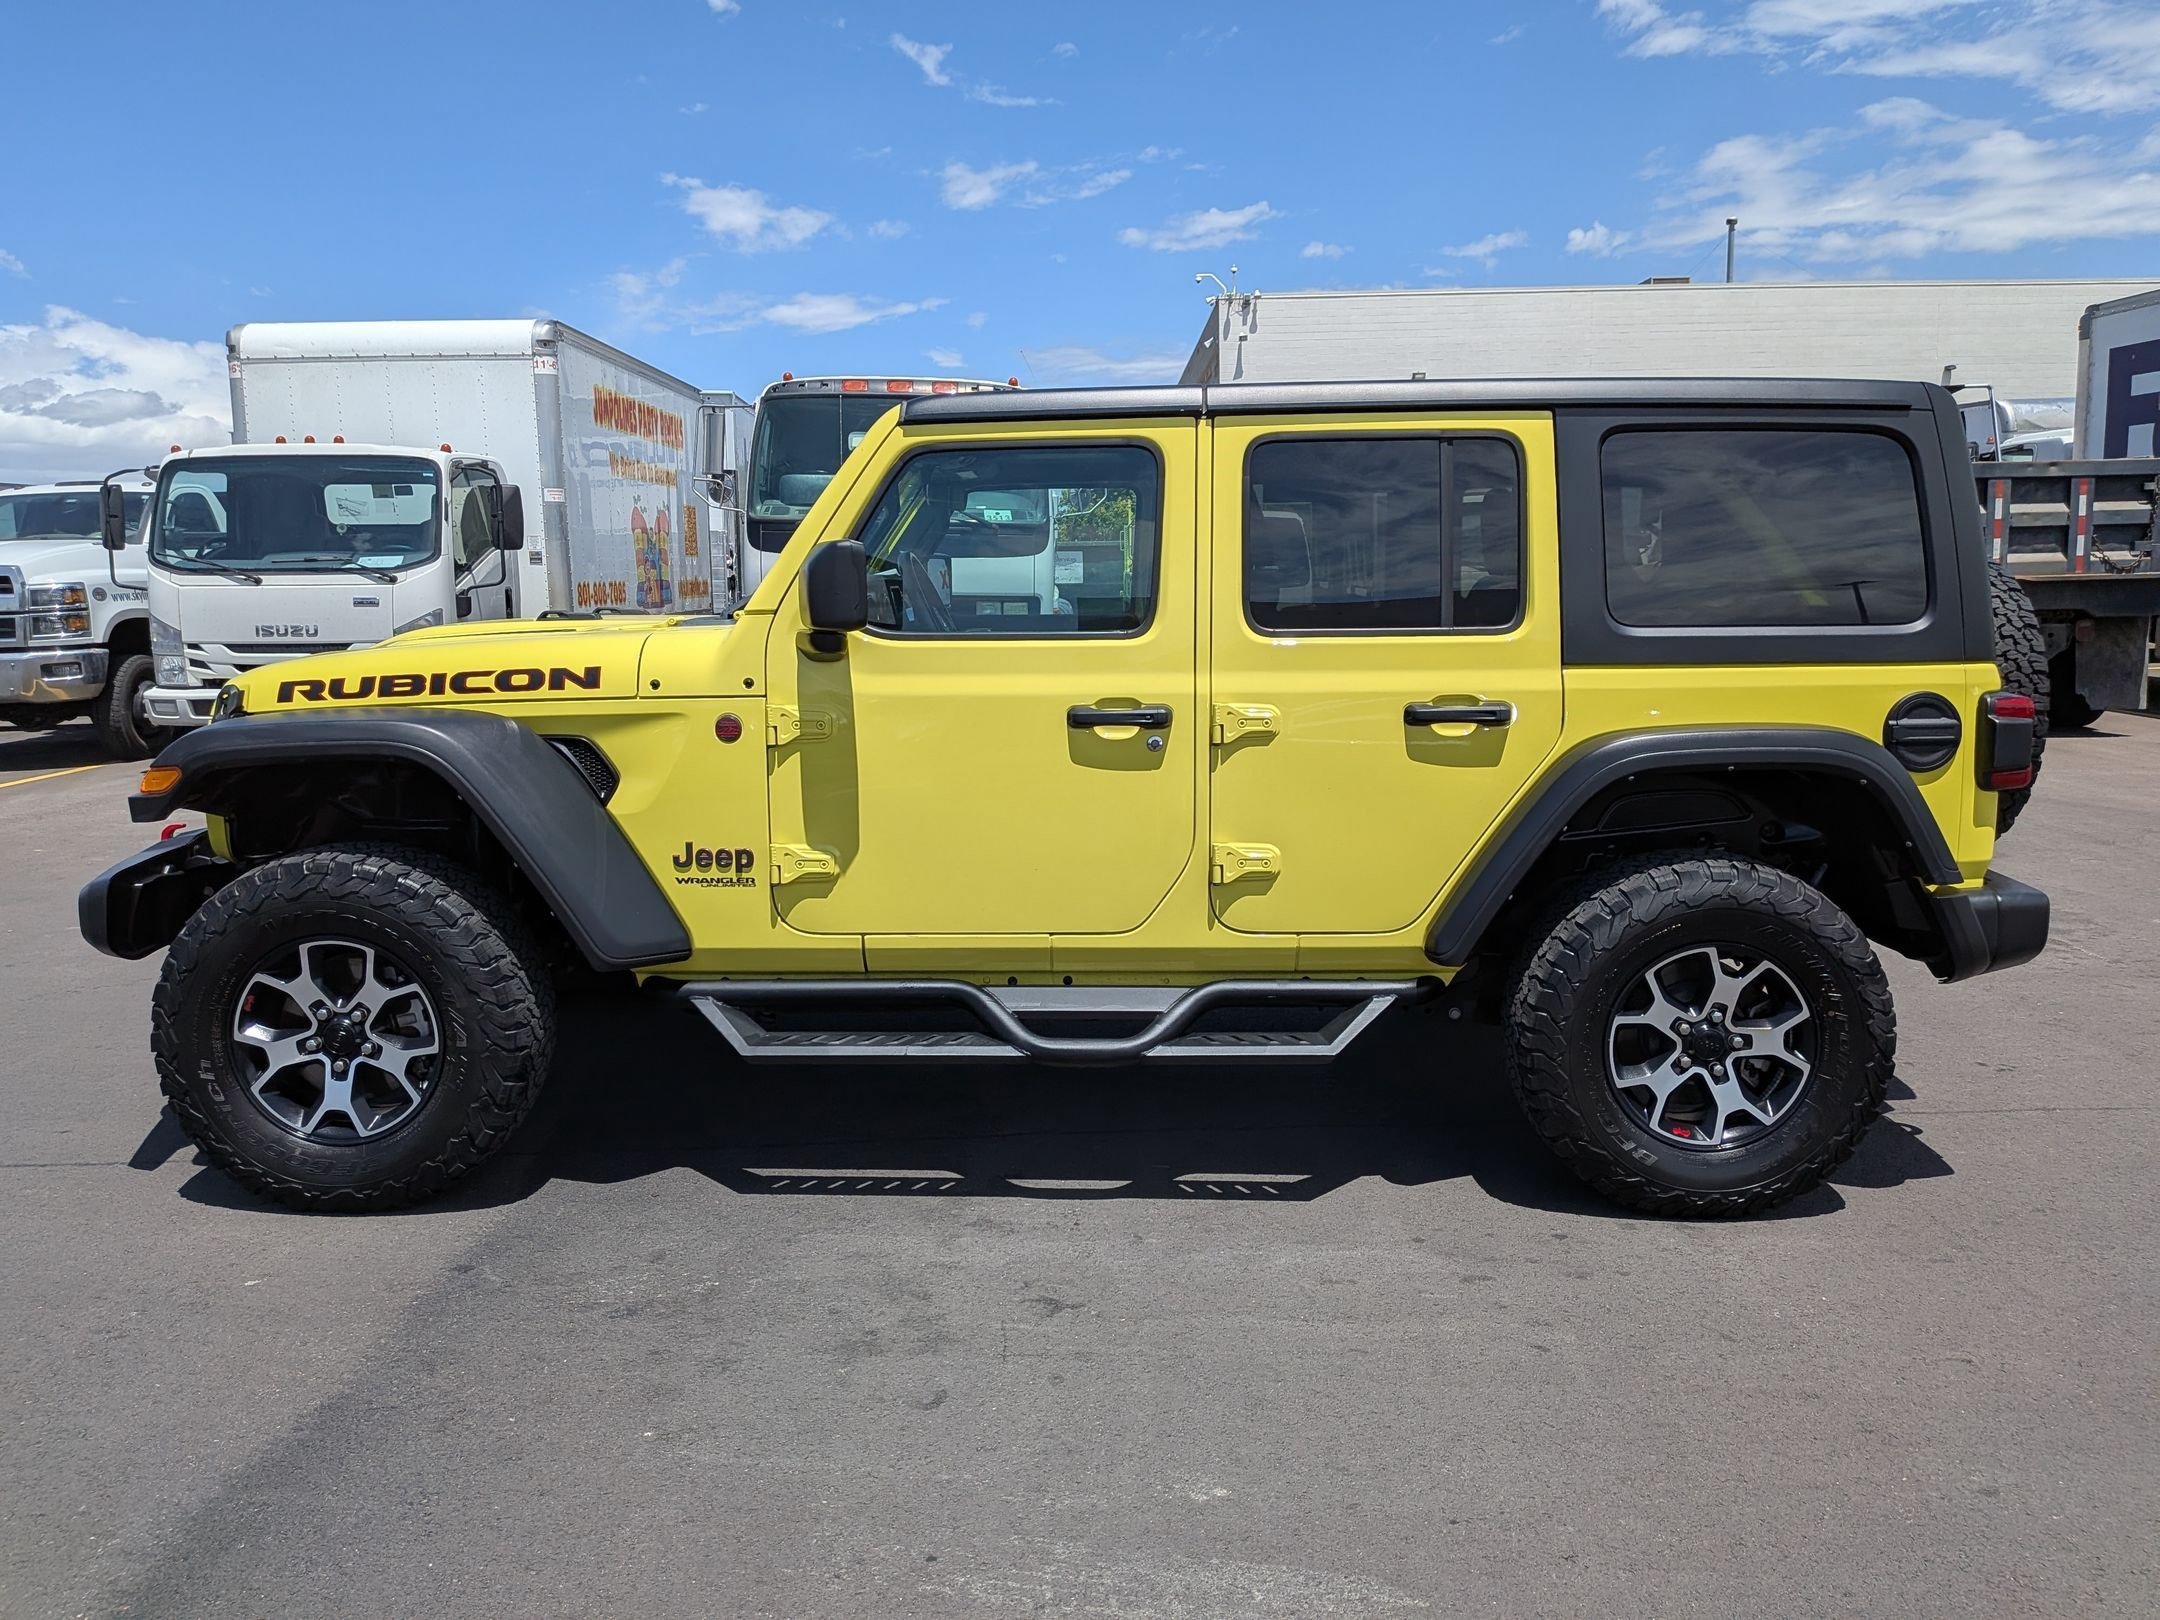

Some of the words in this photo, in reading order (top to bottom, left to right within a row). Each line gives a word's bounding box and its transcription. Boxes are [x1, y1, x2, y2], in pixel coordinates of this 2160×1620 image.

[255, 624, 319, 638] ISUZU
[277, 666, 602, 703] RUBICON
[672, 841, 755, 877] Jeep
